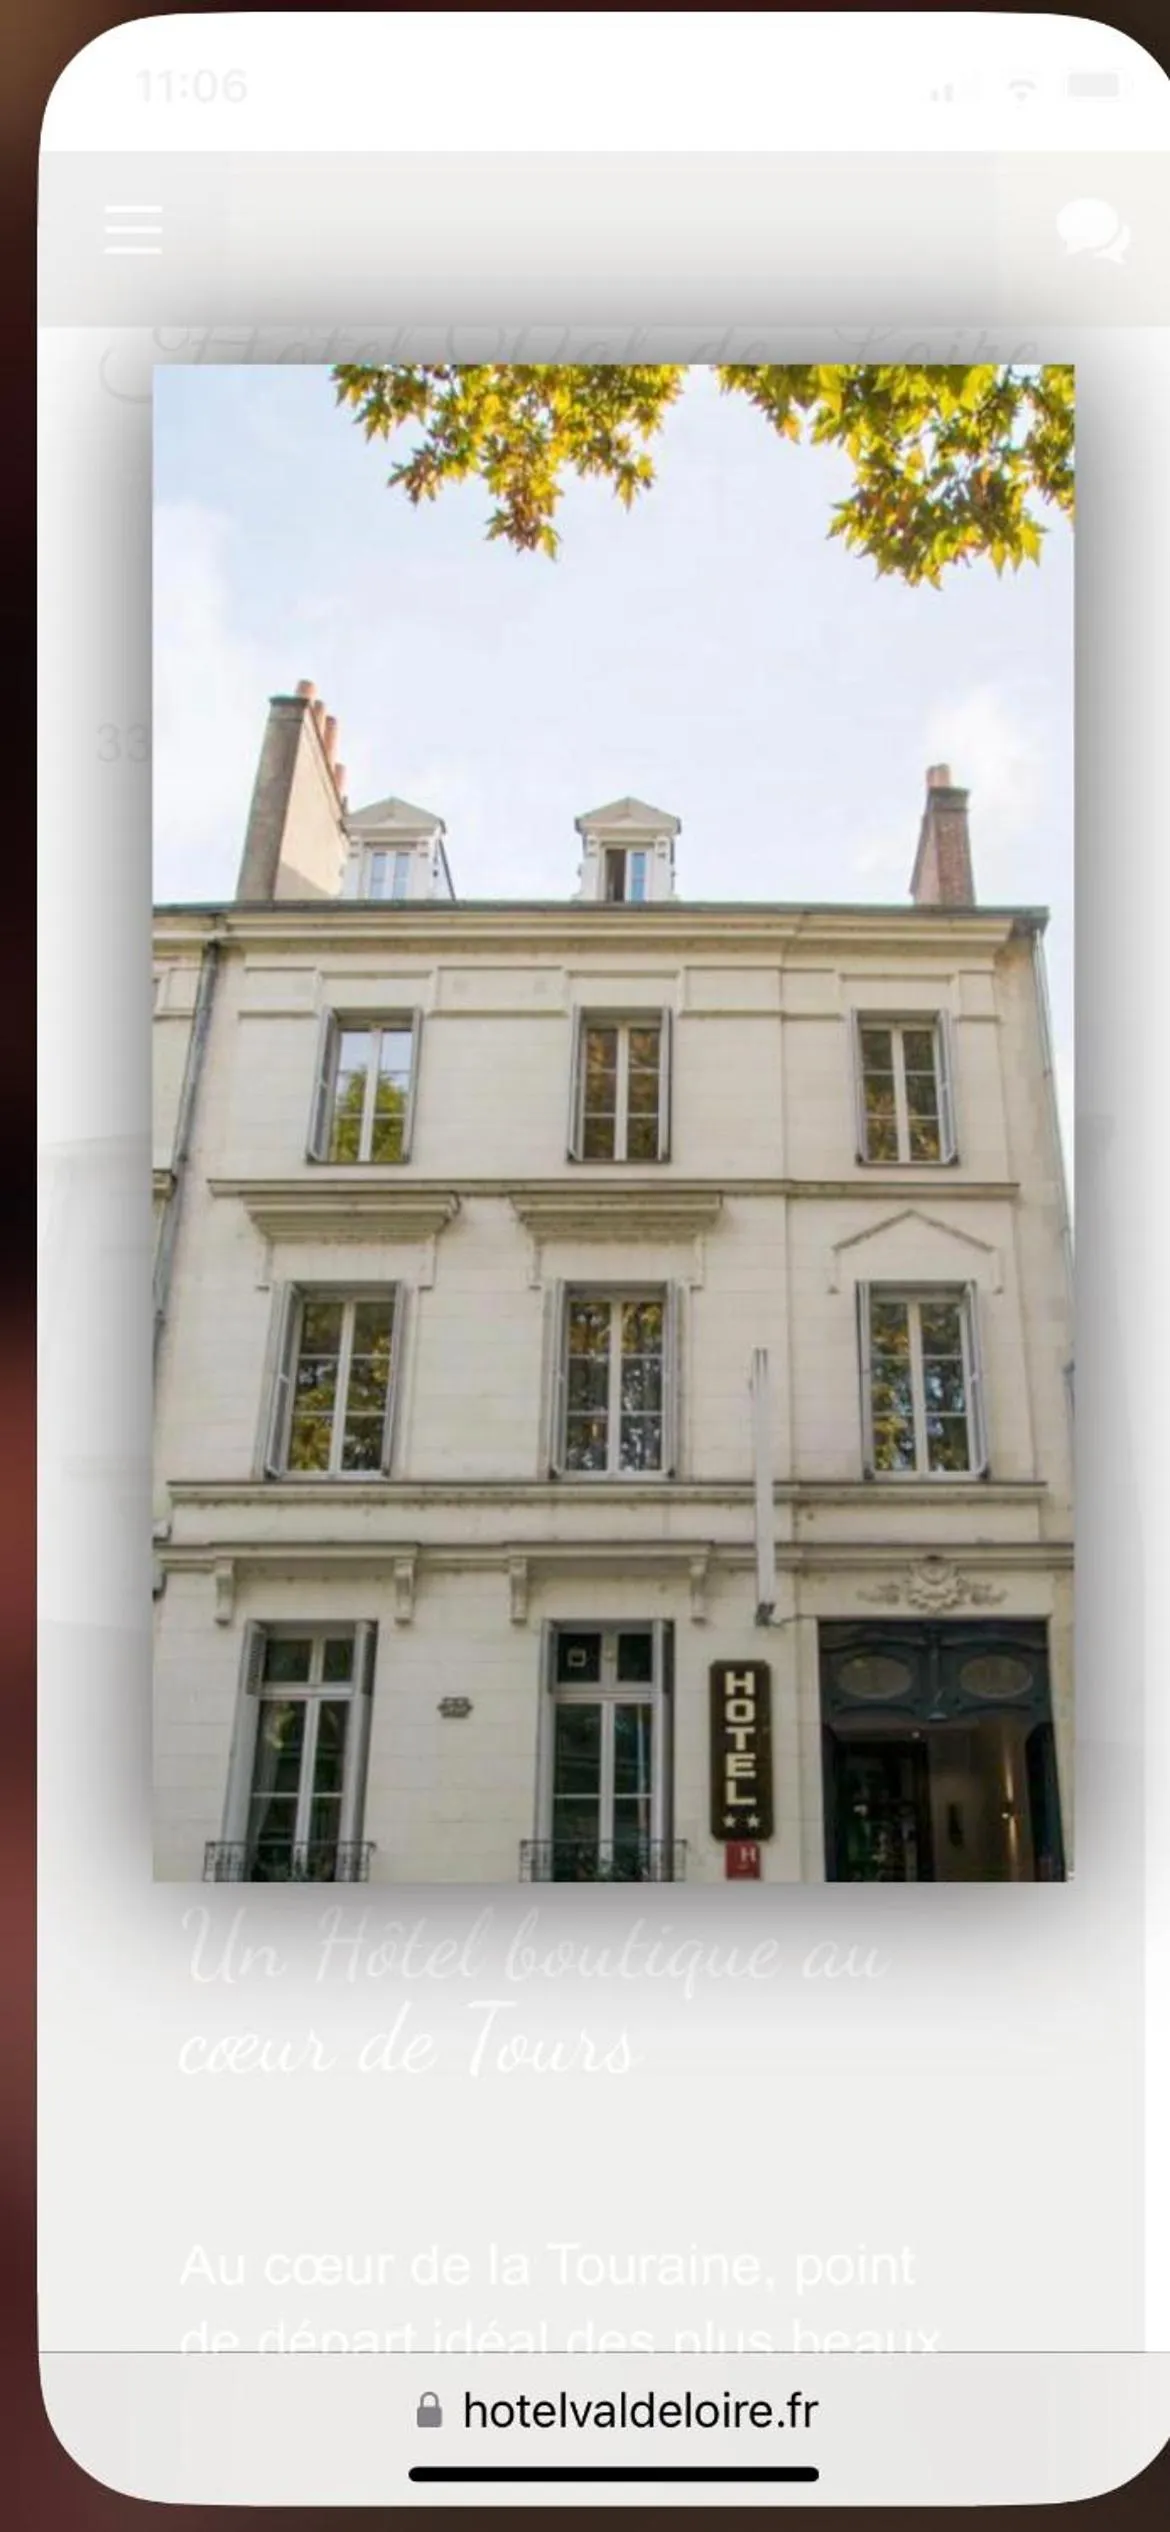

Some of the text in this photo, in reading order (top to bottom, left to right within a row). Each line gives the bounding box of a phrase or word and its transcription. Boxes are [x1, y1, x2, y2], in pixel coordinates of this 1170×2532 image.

[135, 69, 248, 104] 11:06
[724, 1671, 757, 1806] HOTEL
[181, 1905, 893, 2000] Un Hôtel boutique au
[178, 2000, 638, 2078] cœur de Tours
[179, 2242, 916, 2296] Au cœur de la Touraine, point
[180, 2319, 240, 2352] de
[434, 2318, 548, 2352] idéal
[566, 2319, 655, 2352] des
[793, 2318, 941, 2352] beaux
[464, 2390, 820, 2429] hotelvaldeloire.fr
